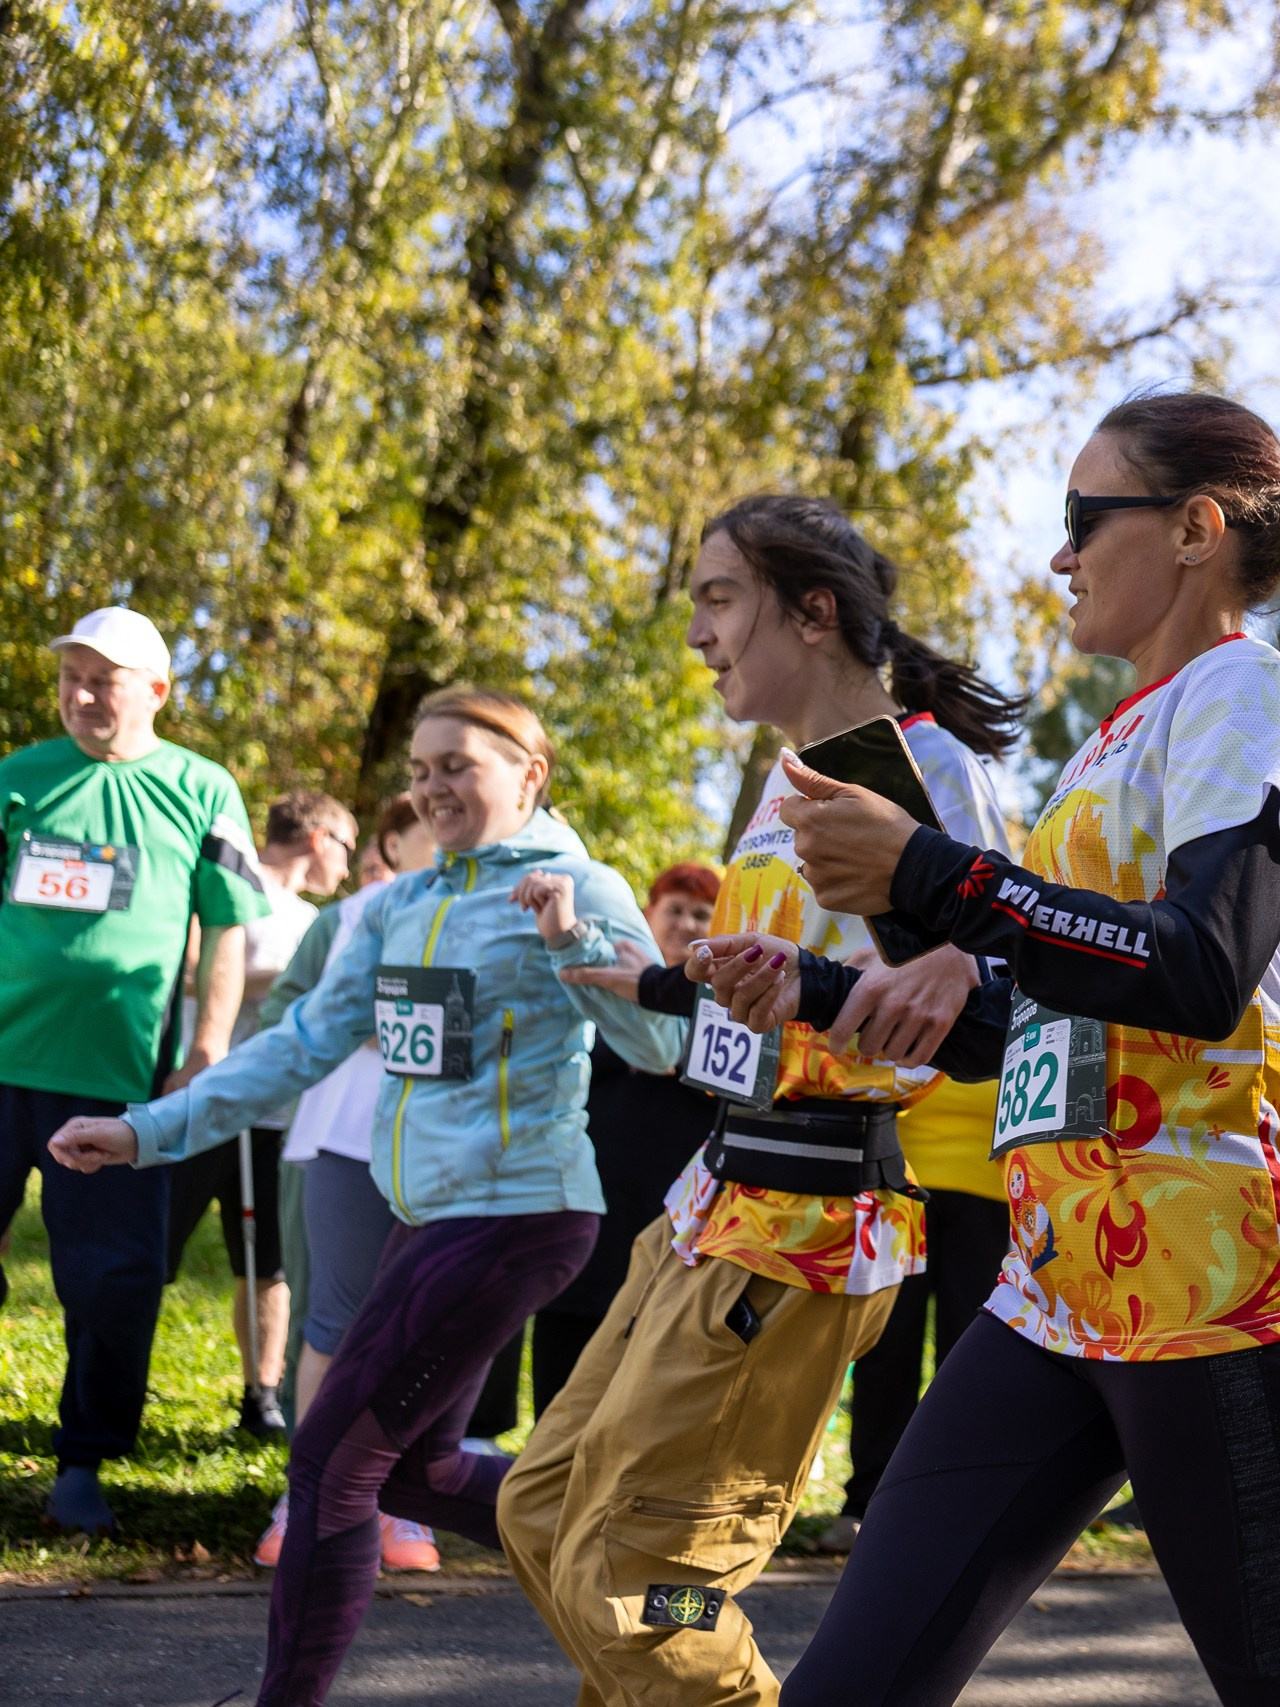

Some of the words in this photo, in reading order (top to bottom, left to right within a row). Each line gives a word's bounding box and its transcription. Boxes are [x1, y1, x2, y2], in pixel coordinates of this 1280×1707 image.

[38, 871, 89, 900] 56
[380, 1021, 436, 1066] 626
[702, 1024, 752, 1085] 152
[998, 1051, 1059, 1135] 582
